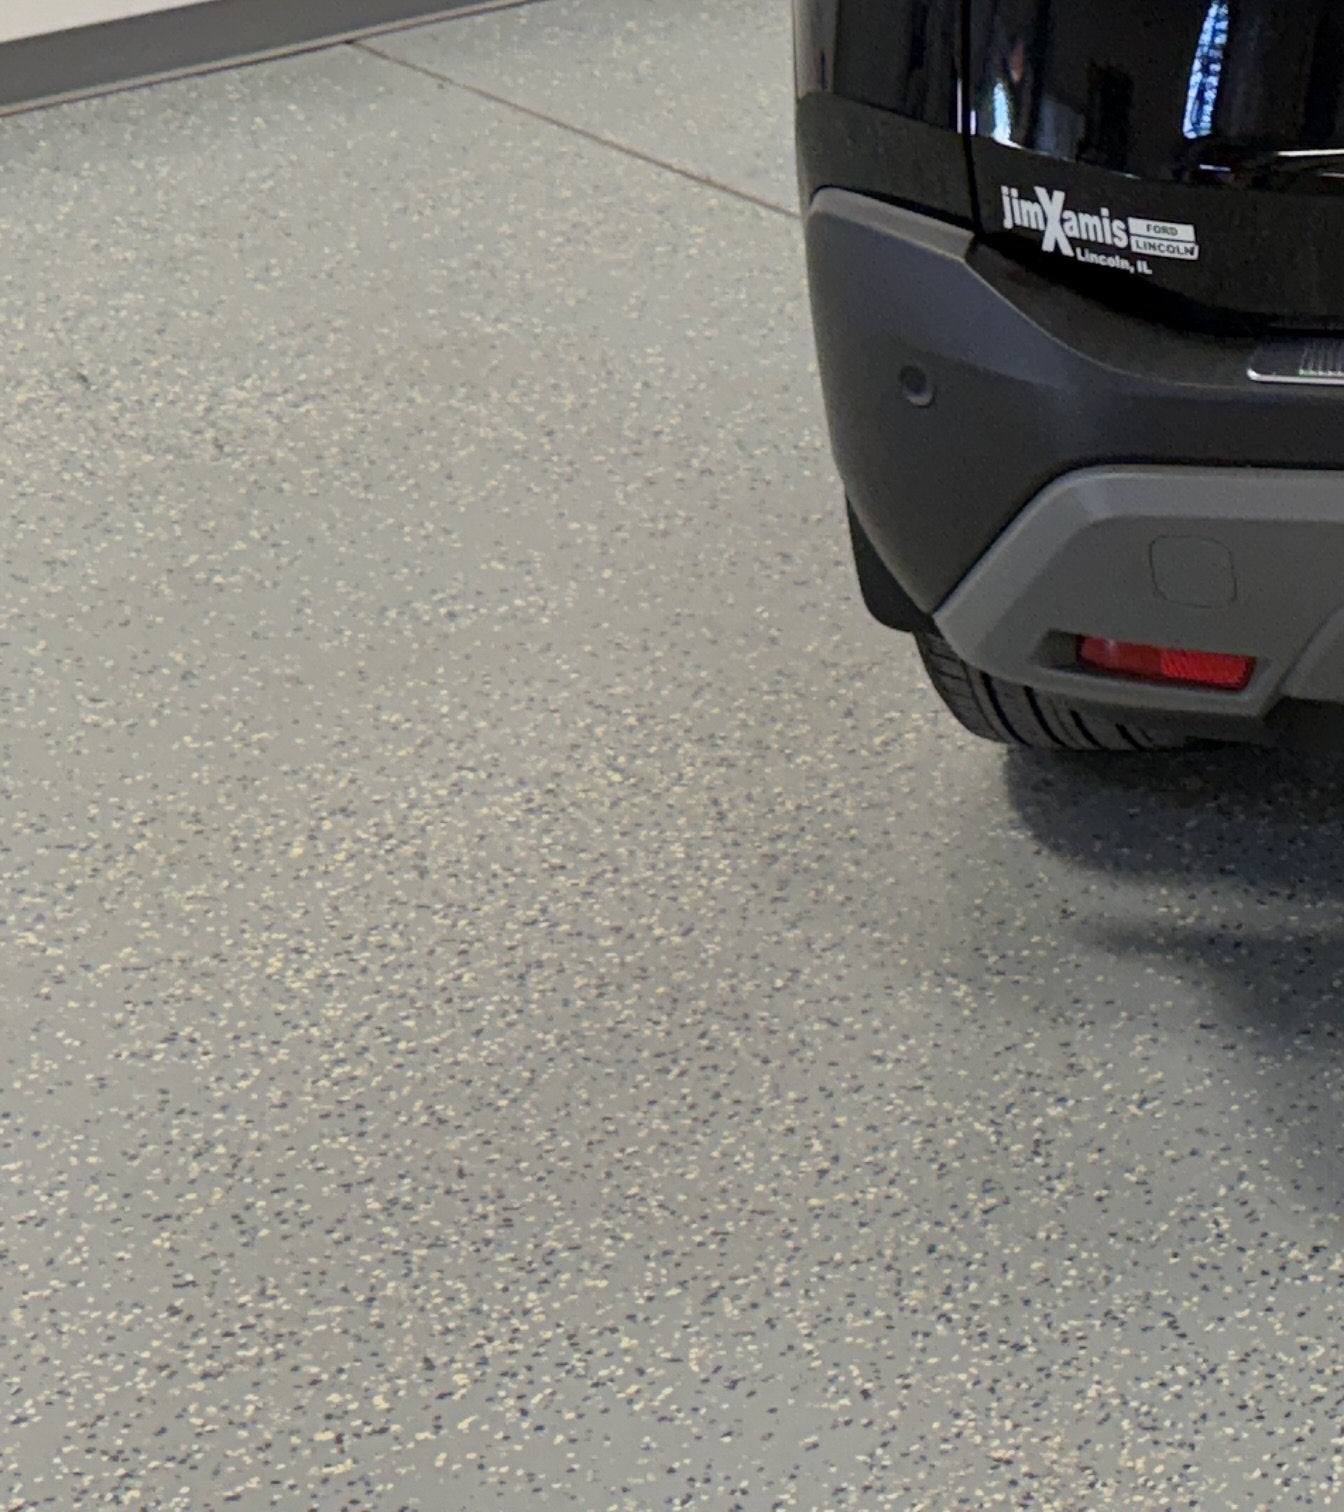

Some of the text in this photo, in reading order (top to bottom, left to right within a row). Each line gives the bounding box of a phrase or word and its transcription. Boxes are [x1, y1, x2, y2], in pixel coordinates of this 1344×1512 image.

[1000, 185, 1129, 258] jimXamis
[1146, 223, 1178, 237] FORD
[1135, 239, 1195, 257] LINCOLN
[1076, 247, 1152, 275] Lincoln, IL
